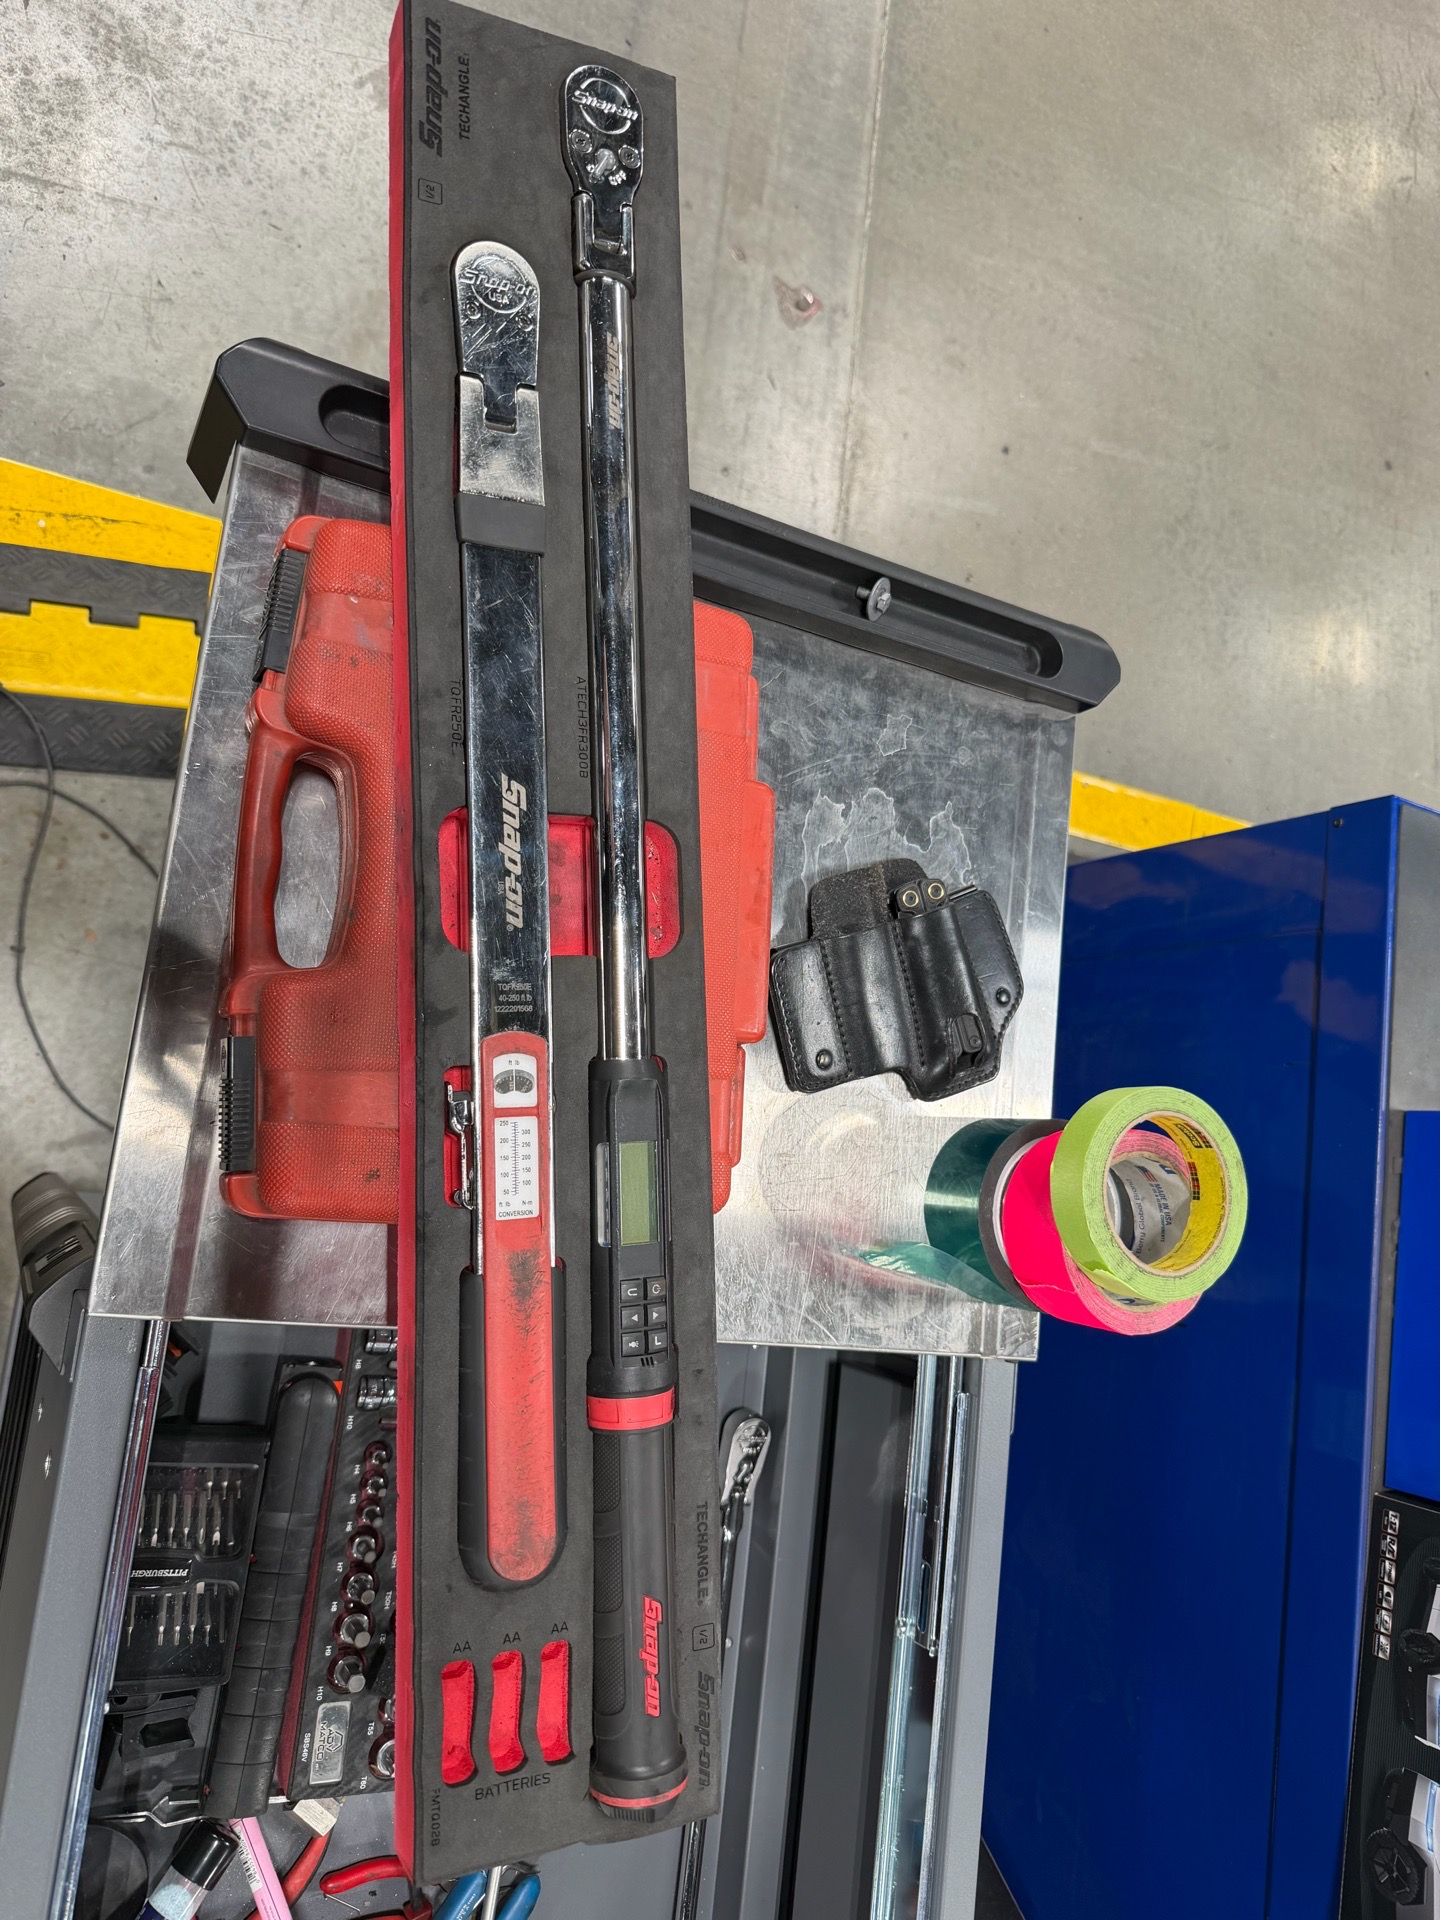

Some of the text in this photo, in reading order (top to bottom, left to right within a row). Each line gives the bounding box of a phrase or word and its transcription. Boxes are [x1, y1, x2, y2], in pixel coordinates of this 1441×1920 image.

[419, 17, 448, 157] Snap-on
[458, 56, 470, 141] TECHANGLE
[572, 90, 639, 120] Snap-on
[460, 267, 538, 297] Snap-on
[488, 291, 510, 304] USA
[604, 331, 621, 430] Snap-on
[450, 680, 463, 755] TQFR250E
[576, 676, 589, 779] ATECH3FR300B
[499, 772, 527, 929] Snap-on
[499, 994, 520, 1002] 40-250
[1136, 1202, 1144, 1230] Global
[1154, 1184, 1172, 1226] MADE IN USA
[696, 1502, 708, 1599] TECHANGLE
[131, 1568, 189, 1577] PITTSBURGH
[337, 1562, 343, 1572] H7
[503, 1632, 521, 1645] AA
[551, 1621, 568, 1634] AA
[453, 1641, 472, 1654] AA
[640, 1594, 662, 1717] Snap-on
[316, 1720, 327, 1761] MATCO
[367, 1721, 375, 1735] T55
[695, 1671, 714, 1786] Snap-on
[475, 1772, 551, 1801] BATTERIES
